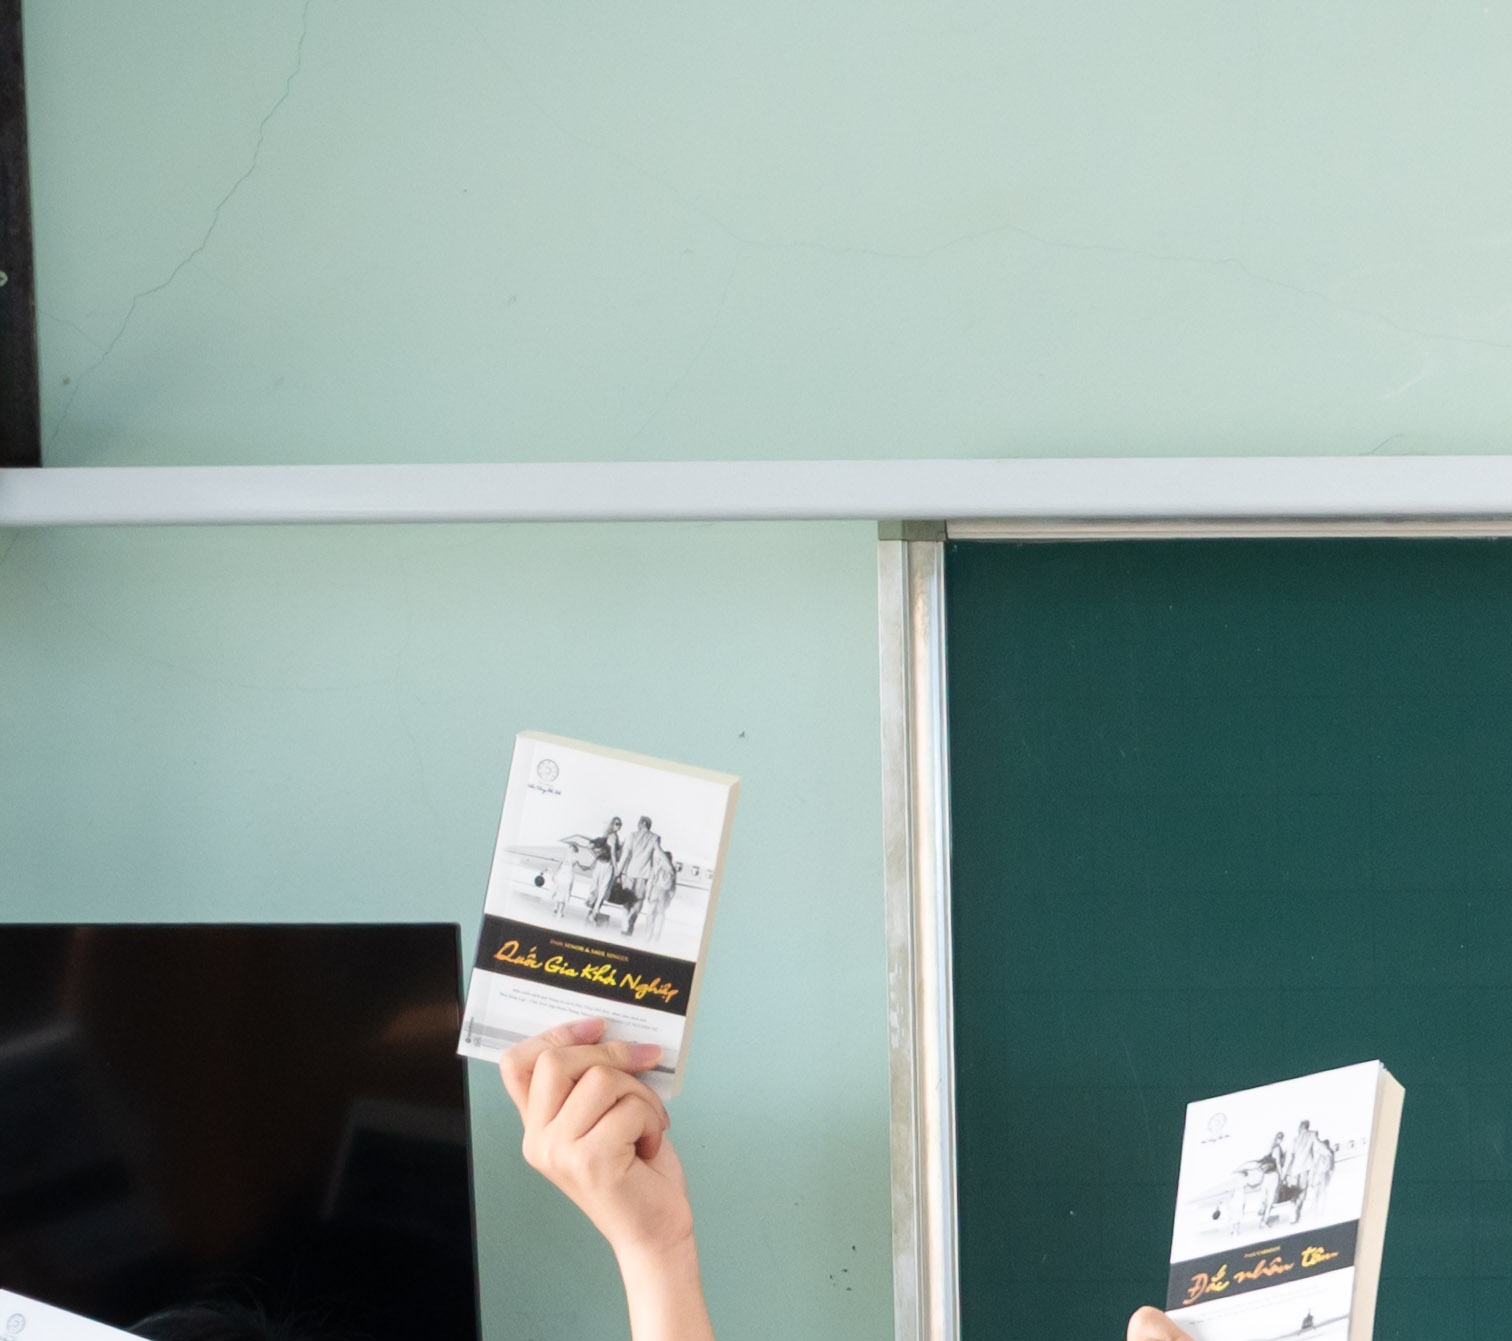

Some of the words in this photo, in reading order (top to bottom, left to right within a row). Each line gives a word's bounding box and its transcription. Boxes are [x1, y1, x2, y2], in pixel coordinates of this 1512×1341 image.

[493, 940, 542, 970] Quốc
[544, 956, 579, 977] Gia
[620, 973, 681, 1003] Nghiệp
[1182, 1263, 1231, 1306] Đắc
[1233, 1255, 1295, 1281] nhân
